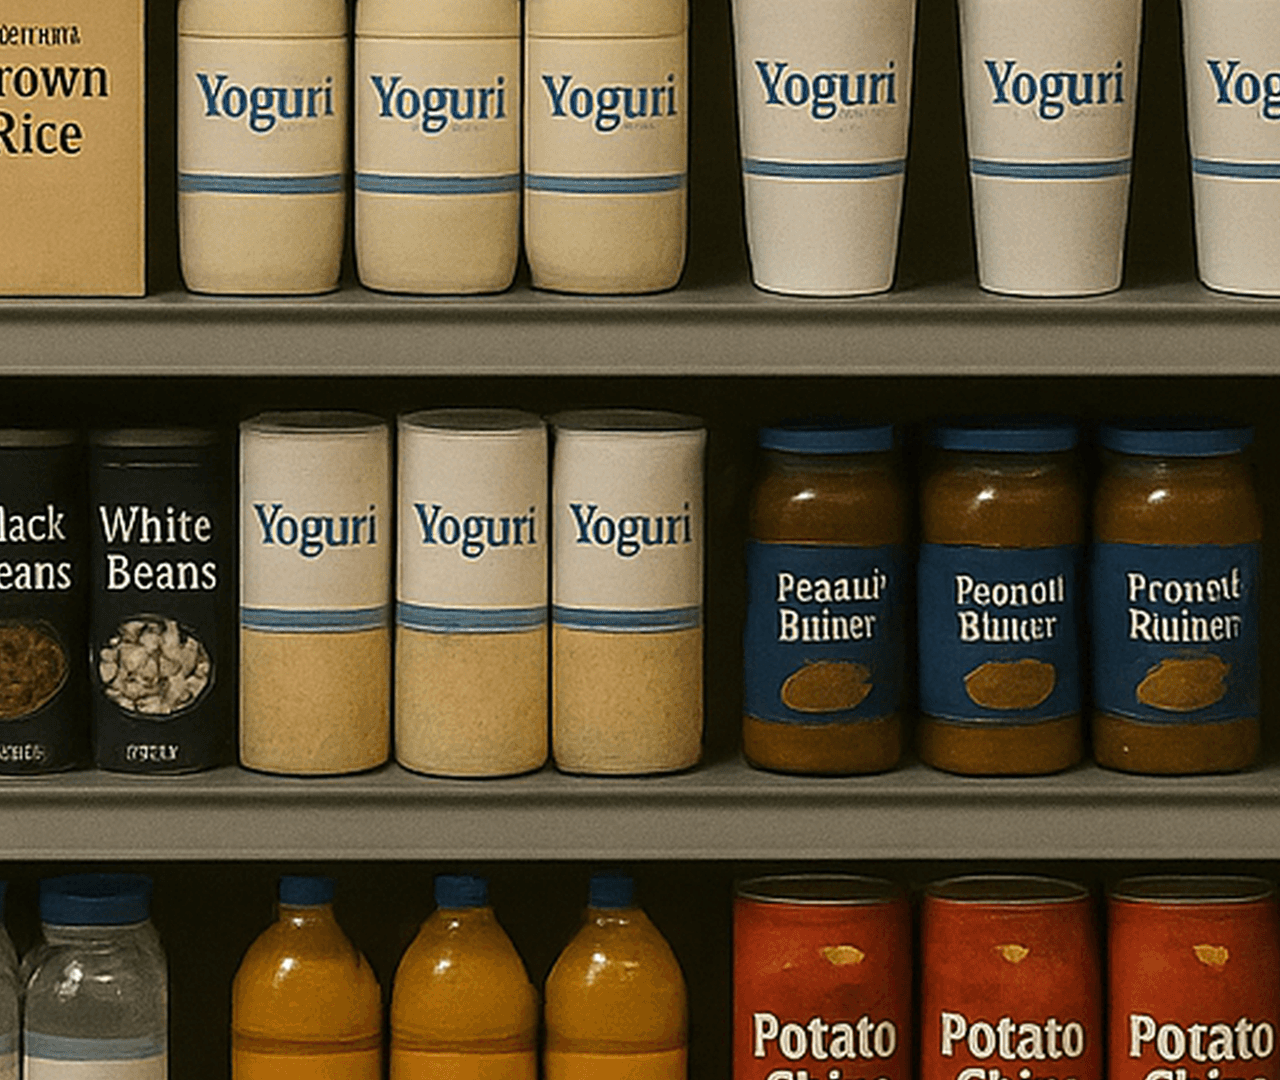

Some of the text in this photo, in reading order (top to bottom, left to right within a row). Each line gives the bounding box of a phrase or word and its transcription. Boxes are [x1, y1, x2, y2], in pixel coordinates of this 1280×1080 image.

[99, 506, 211, 543] White
[107, 554, 216, 590] Beans
[752, 1012, 896, 1060] Potato
[941, 1011, 1084, 1059] Potato
[1128, 1013, 1274, 1061] Potato
